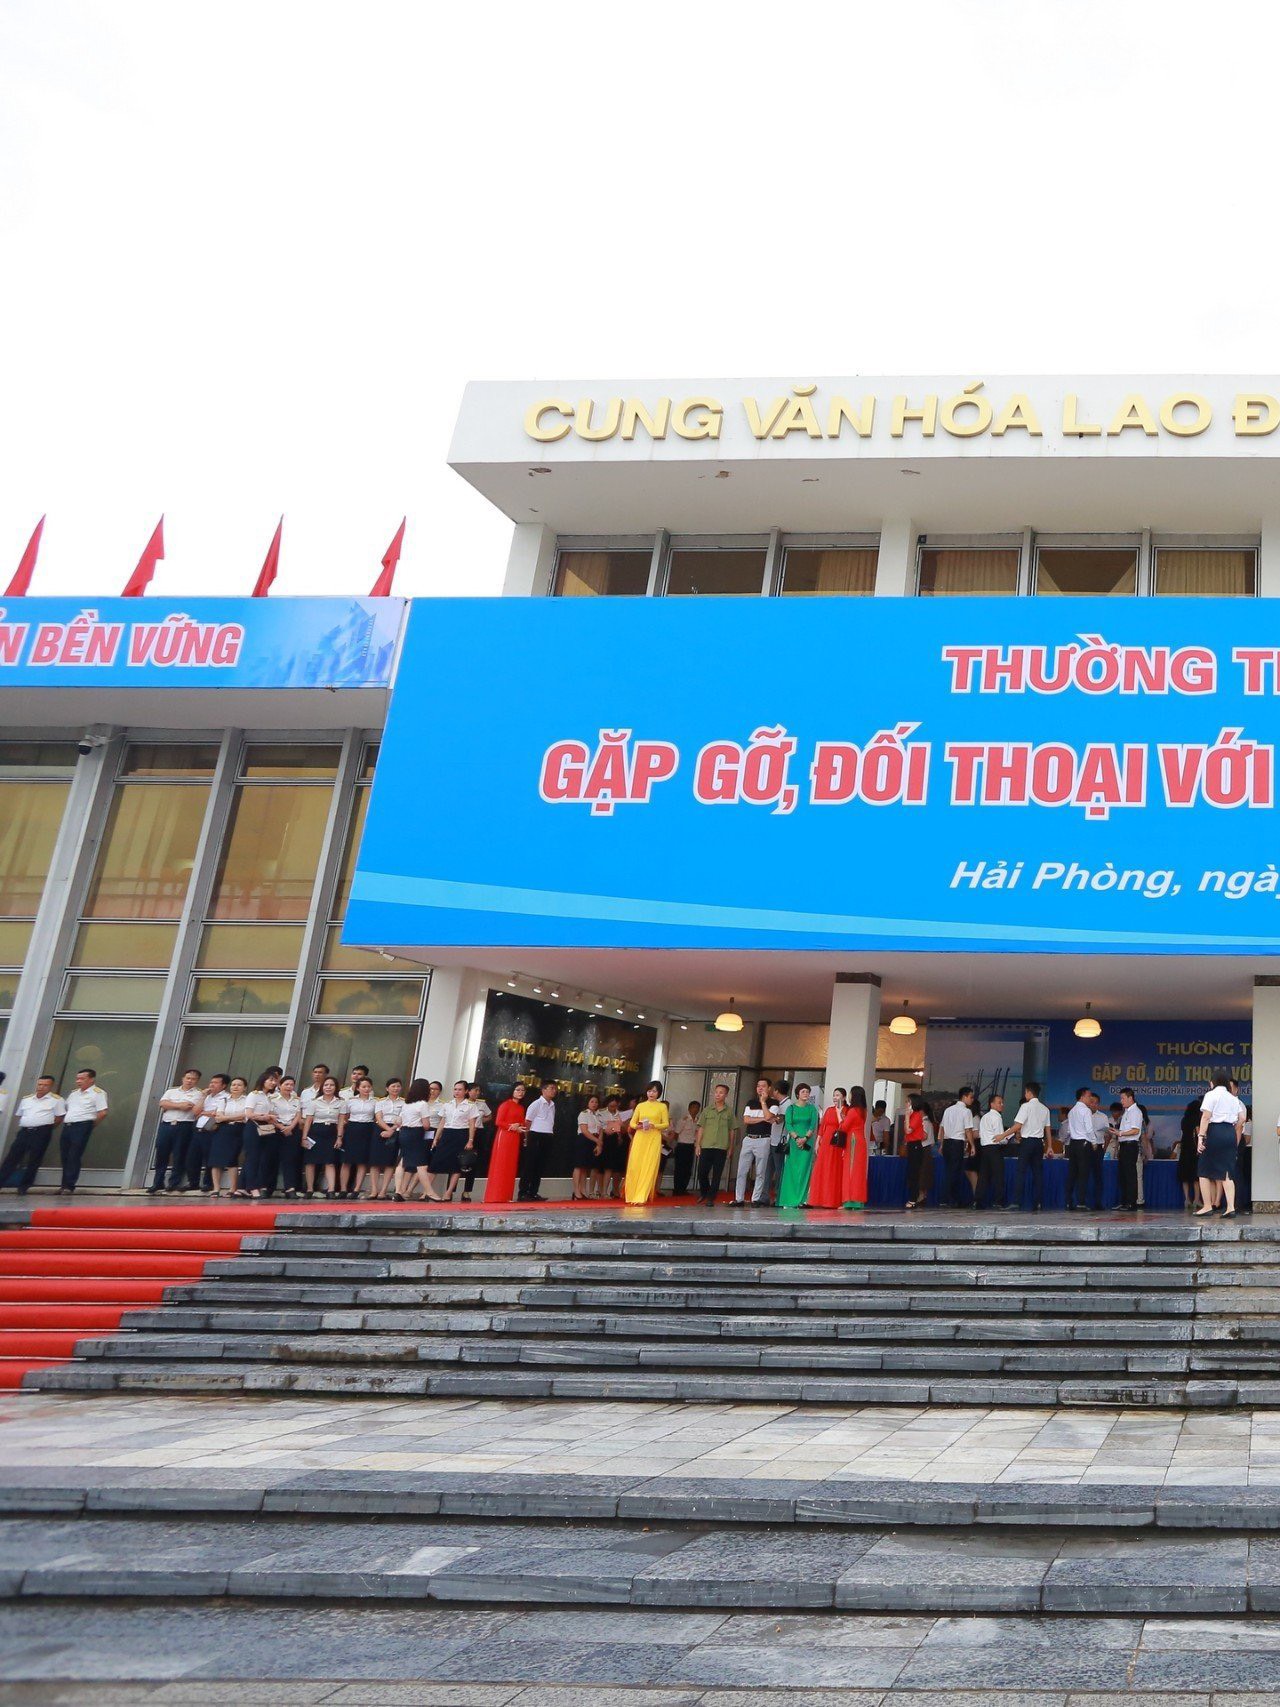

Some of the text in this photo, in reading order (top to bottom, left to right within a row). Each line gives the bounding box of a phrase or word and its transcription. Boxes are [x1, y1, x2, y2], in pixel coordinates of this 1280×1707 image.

[523, 398, 723, 442] CUNG
[742, 385, 877, 440] VĂN
[891, 381, 1043, 438] HÓA
[1061, 393, 1212, 438] LAO
[28, 608, 130, 667] BỀN
[127, 612, 245, 668] VỮNG
[942, 634, 1217, 694] THƯỜNG
[538, 728, 680, 816] GẶP
[693, 723, 799, 815] GỠ,
[809, 721, 931, 805] ĐỐI
[944, 741, 1148, 821] THOẠI
[1157, 726, 1274, 810] VỚI
[950, 861, 1025, 890] Hải
[1032, 861, 1182, 898] Phòng,
[1092, 1062, 1122, 1084] GẶP
[1154, 1060, 1179, 1081] ĐỐI
[1156, 1040, 1234, 1055] THƯỜNG
